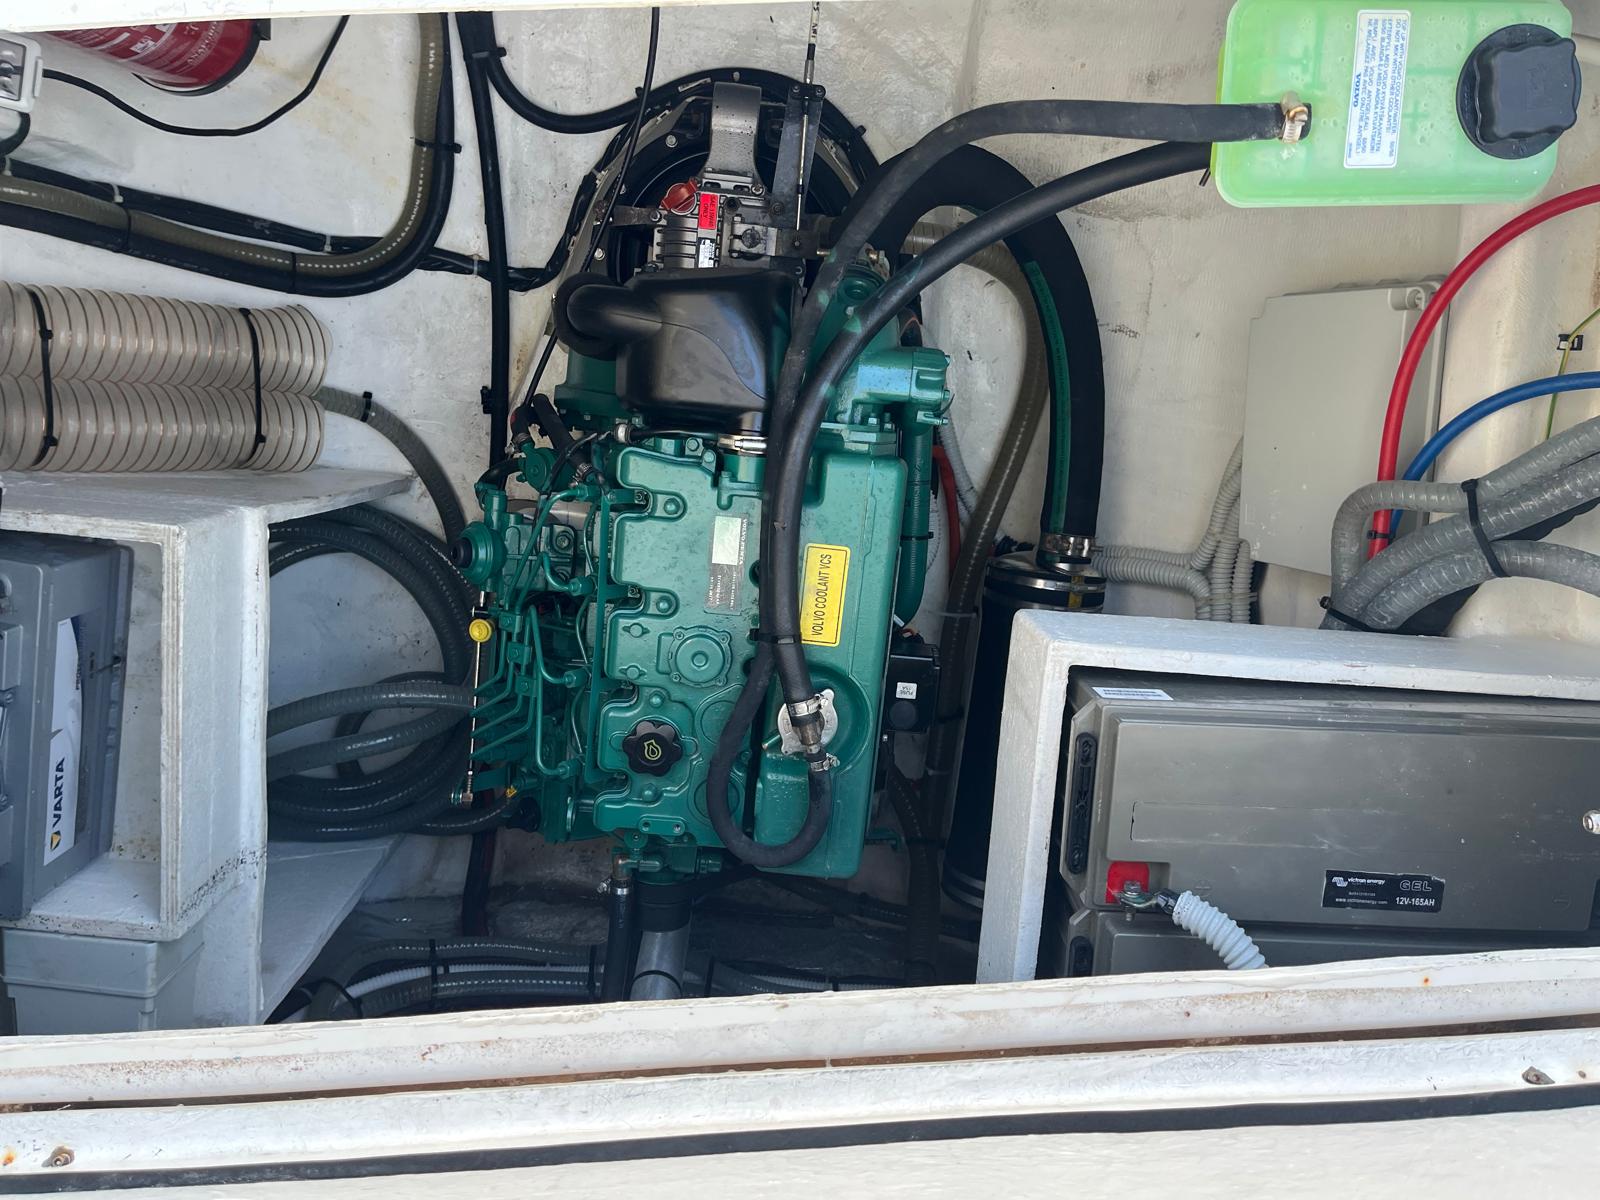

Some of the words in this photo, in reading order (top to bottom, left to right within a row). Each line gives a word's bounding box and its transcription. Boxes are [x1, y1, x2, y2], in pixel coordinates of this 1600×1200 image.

[1396, 19, 1401, 28] DO
[1400, 32, 1406, 41] UP
[1353, 73, 1361, 107] VOLVO
[820, 554, 832, 569] VCS
[814, 571, 830, 609] COOLANT
[811, 610, 825, 636] VOLVO
[50, 757, 67, 829] VARTA
[1400, 880, 1432, 892] GEL
[1396, 897, 1435, 907] 12V-165AH
